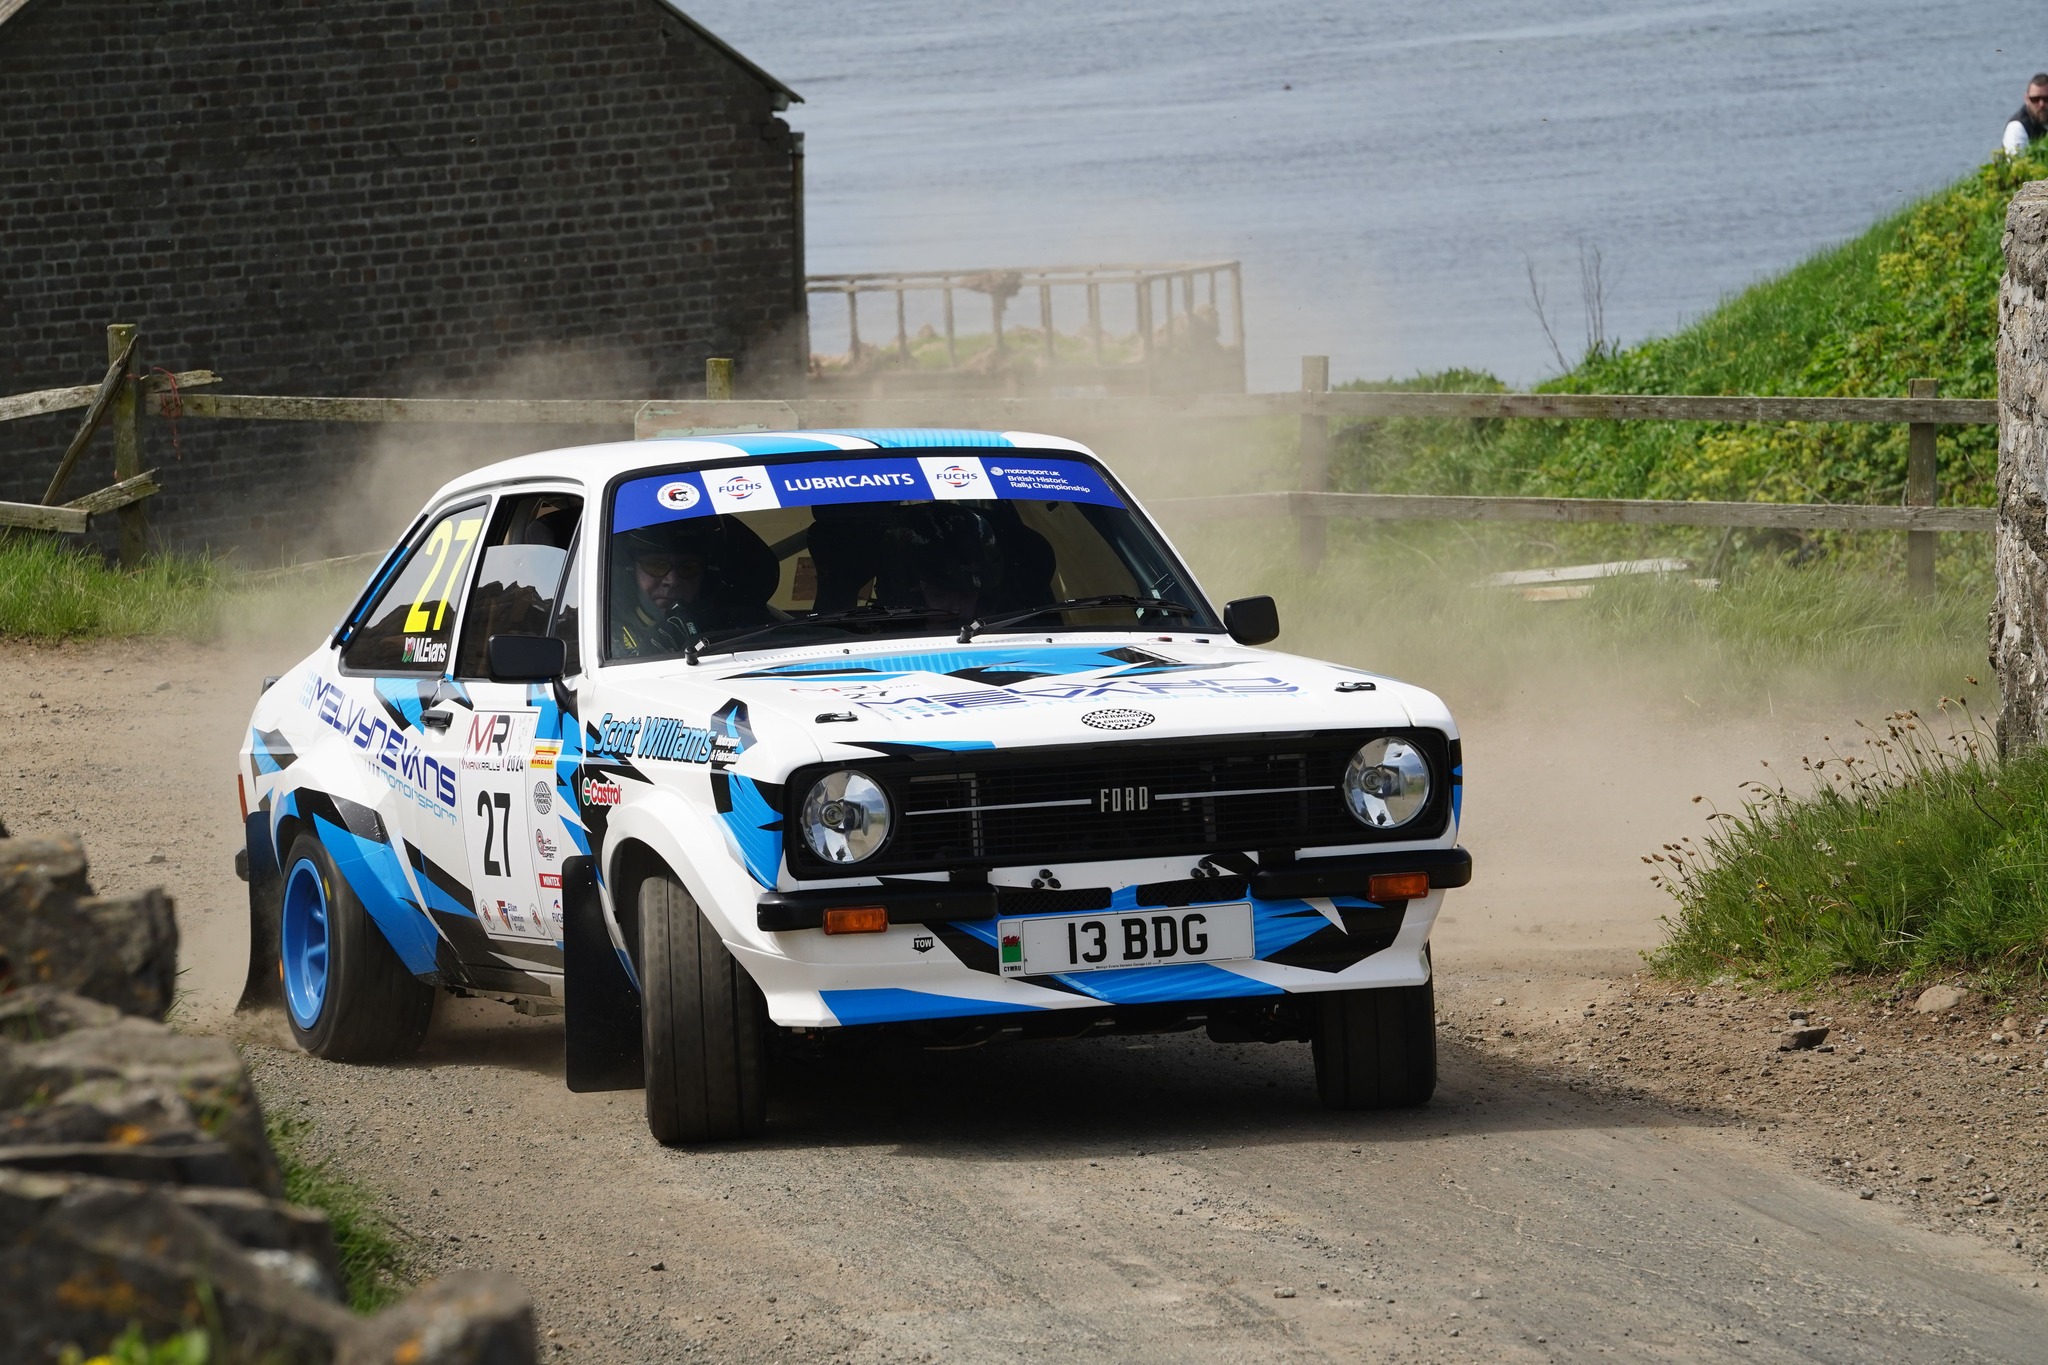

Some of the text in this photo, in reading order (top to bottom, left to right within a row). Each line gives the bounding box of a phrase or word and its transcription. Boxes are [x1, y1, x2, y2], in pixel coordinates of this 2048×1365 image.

[784, 473, 915, 492] LUBRICANTS
[936, 472, 978, 480] FUCHS
[1007, 475, 1069, 485] British Historic
[718, 482, 762, 493] FUCHS
[1010, 481, 1091, 493] Rally Championship
[403, 518, 483, 633] 27
[593, 713, 717, 764] Scott Williams
[531, 749, 557, 765] PIRELLI
[591, 781, 621, 805] Castrol
[1100, 786, 1149, 813] FORD
[477, 790, 511, 878] 27
[915, 939, 932, 948] TOW
[1068, 913, 1209, 965] 13 BDG
